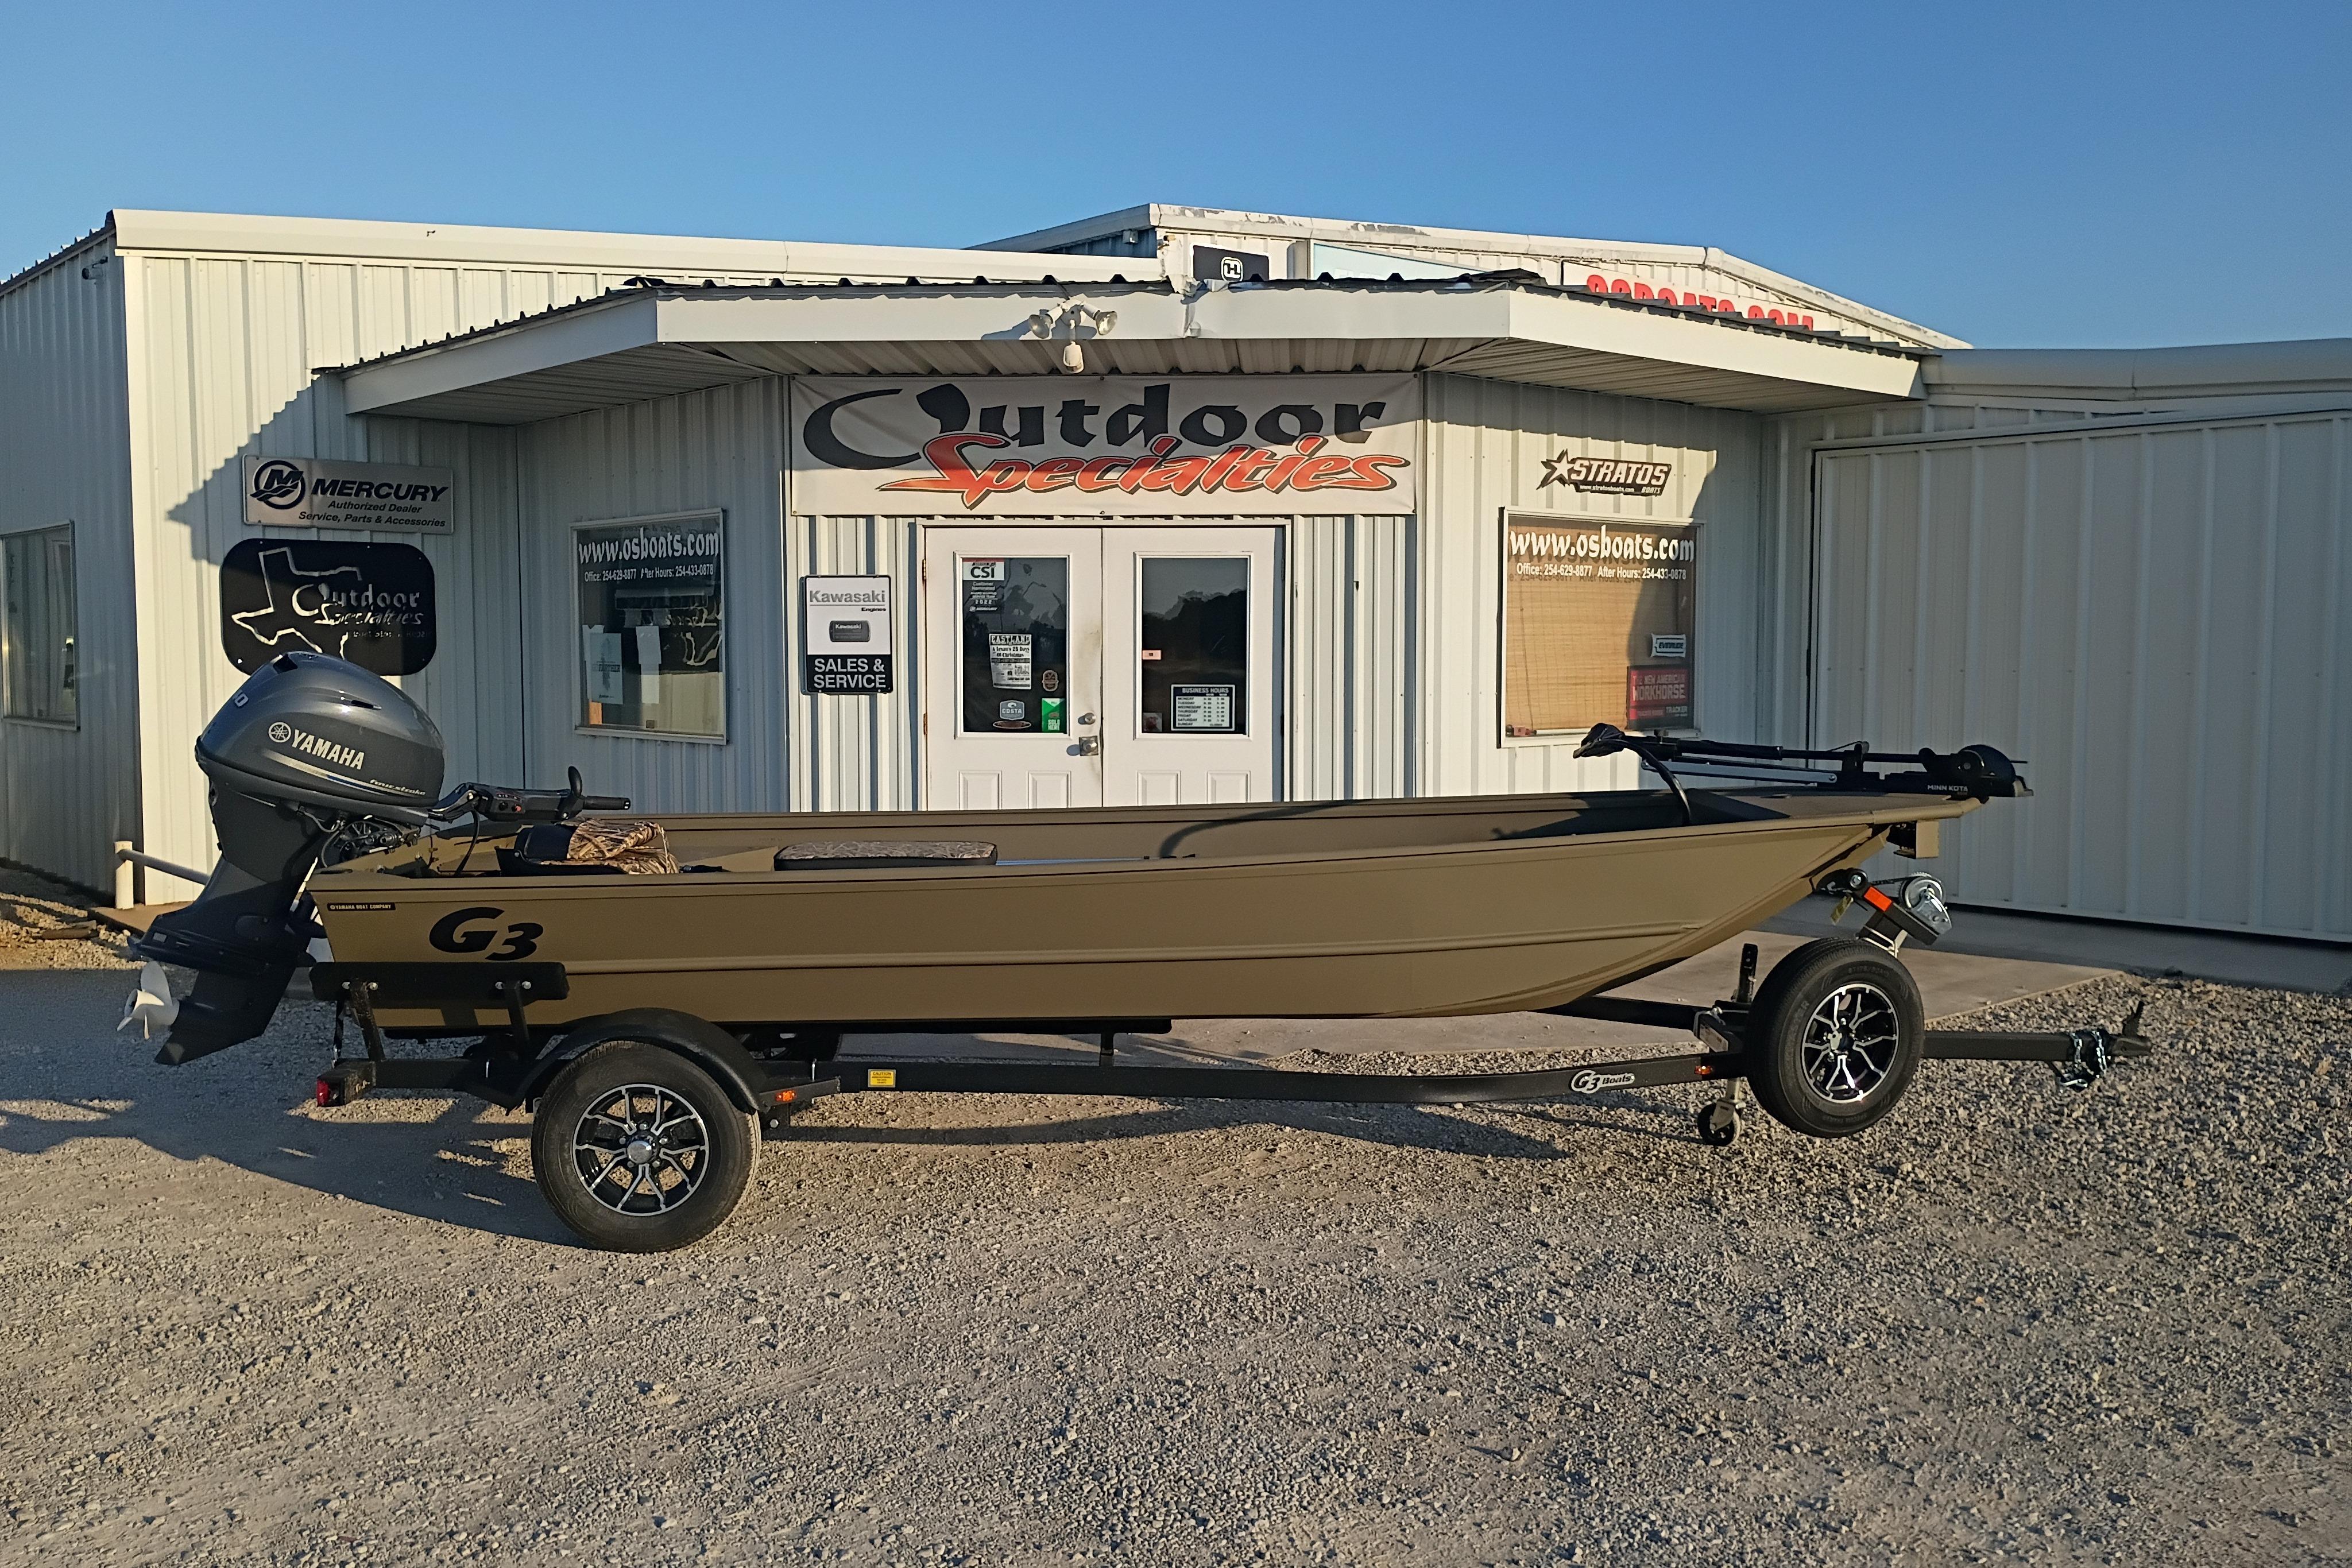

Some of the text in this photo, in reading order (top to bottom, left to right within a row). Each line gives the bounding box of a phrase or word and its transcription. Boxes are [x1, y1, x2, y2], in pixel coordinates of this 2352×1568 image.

[803, 383, 1386, 470] Outdoor
[876, 433, 1411, 510] Specialties
[1570, 459, 1668, 485] STRATOS
[311, 478, 448, 502] MERCURY
[328, 501, 422, 514] Authorized Dealer
[299, 511, 446, 527] Service, Parts & Accessories
[578, 526, 718, 564] www.osboats.com
[1510, 524, 1695, 563] www.osboats.com
[585, 571, 601, 582] Office:
[603, 568, 637, 581] 254-629-8877
[655, 567, 674, 578] Hours:
[675, 564, 714, 576] 254-433-0878
[1517, 563, 1686, 580] Office: 254-629-8877 After Hours: 254-433-0878
[292, 583, 420, 617] Outdoor
[810, 590, 885, 603] Kawasaki
[814, 658, 885, 672] SALES &
[814, 674, 886, 688] SERVICE
[1633, 684, 1686, 702] WORKHORSE
[292, 729, 365, 770] YAMAHA
[429, 907, 544, 961] G3
[1573, 1073, 1631, 1091] G3 Boats
